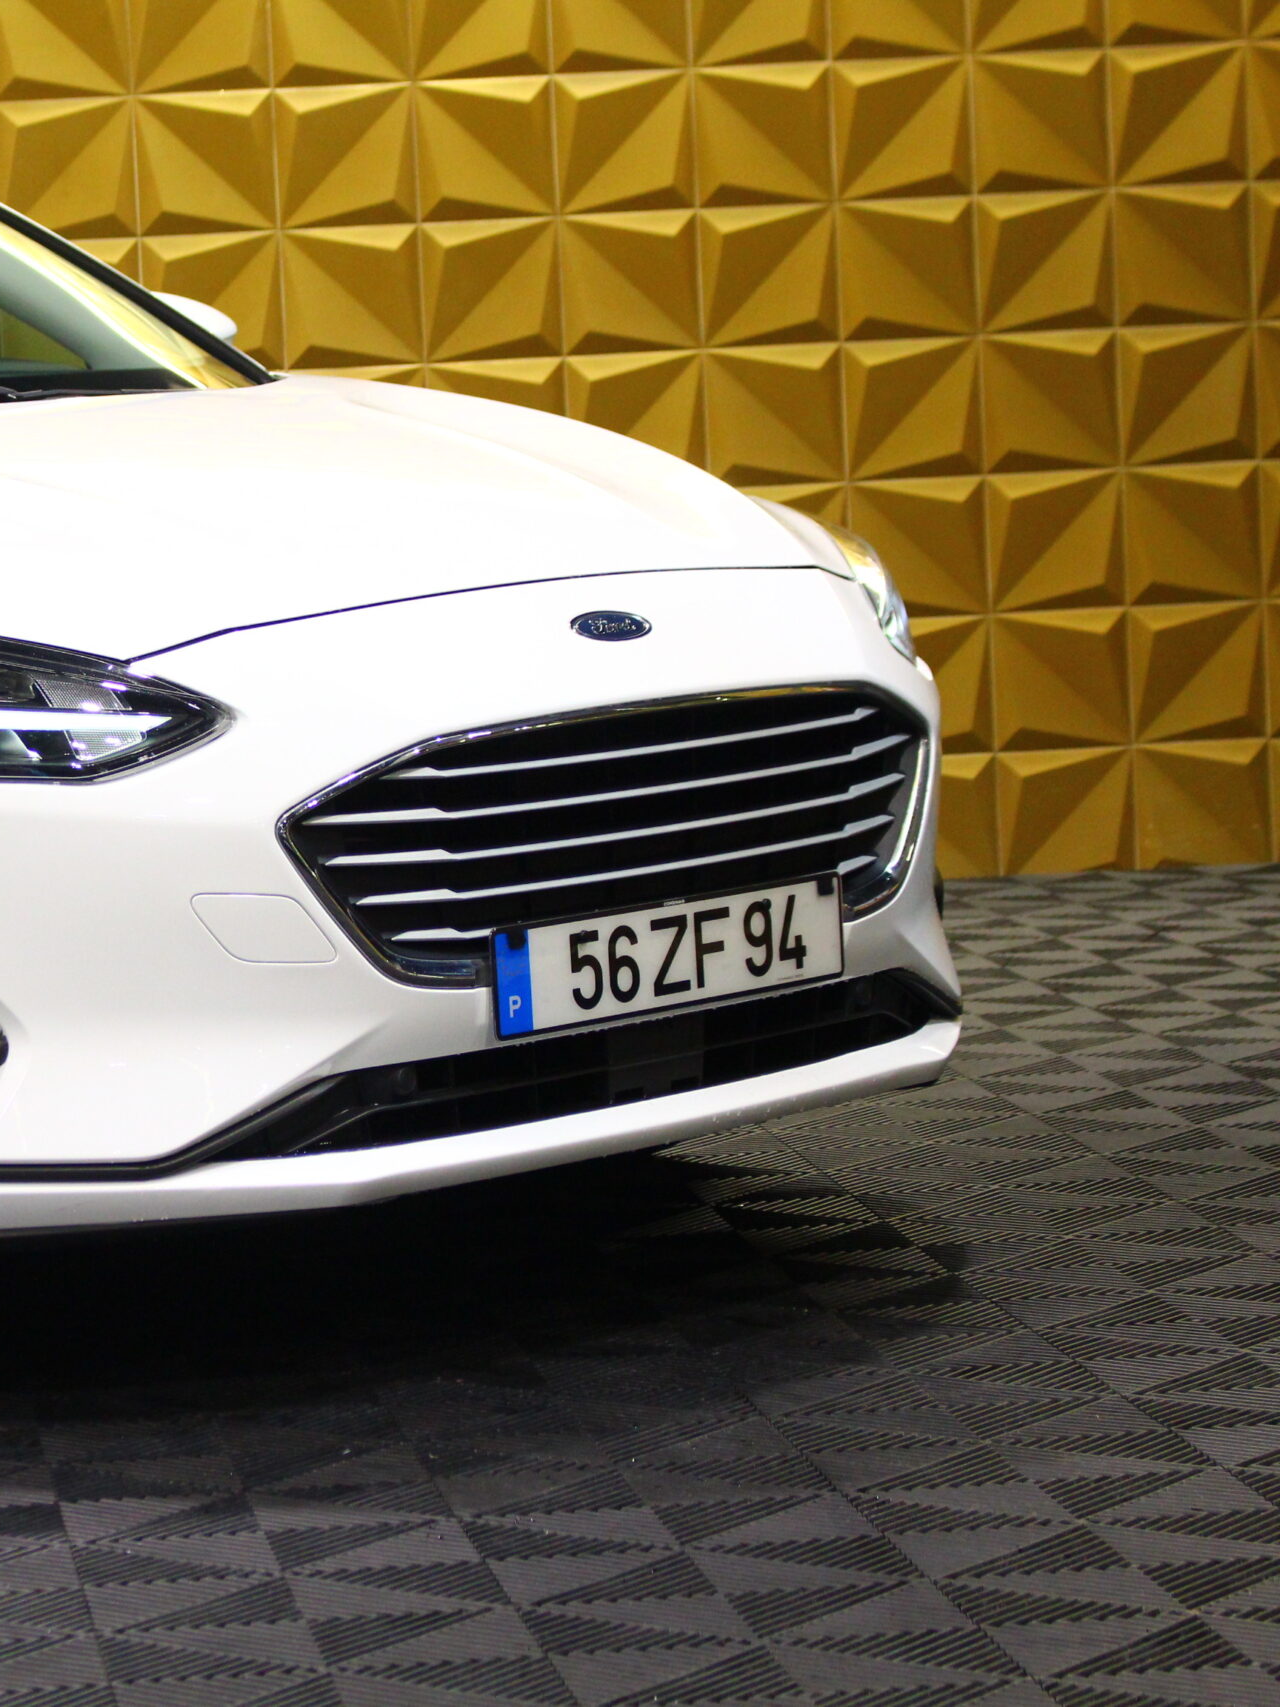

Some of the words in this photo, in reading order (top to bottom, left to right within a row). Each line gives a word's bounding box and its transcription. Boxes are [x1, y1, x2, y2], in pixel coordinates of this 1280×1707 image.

[569, 924, 641, 1011] 56
[650, 906, 730, 998] ZF
[743, 894, 807, 978] 94
[508, 995, 521, 1018] P
